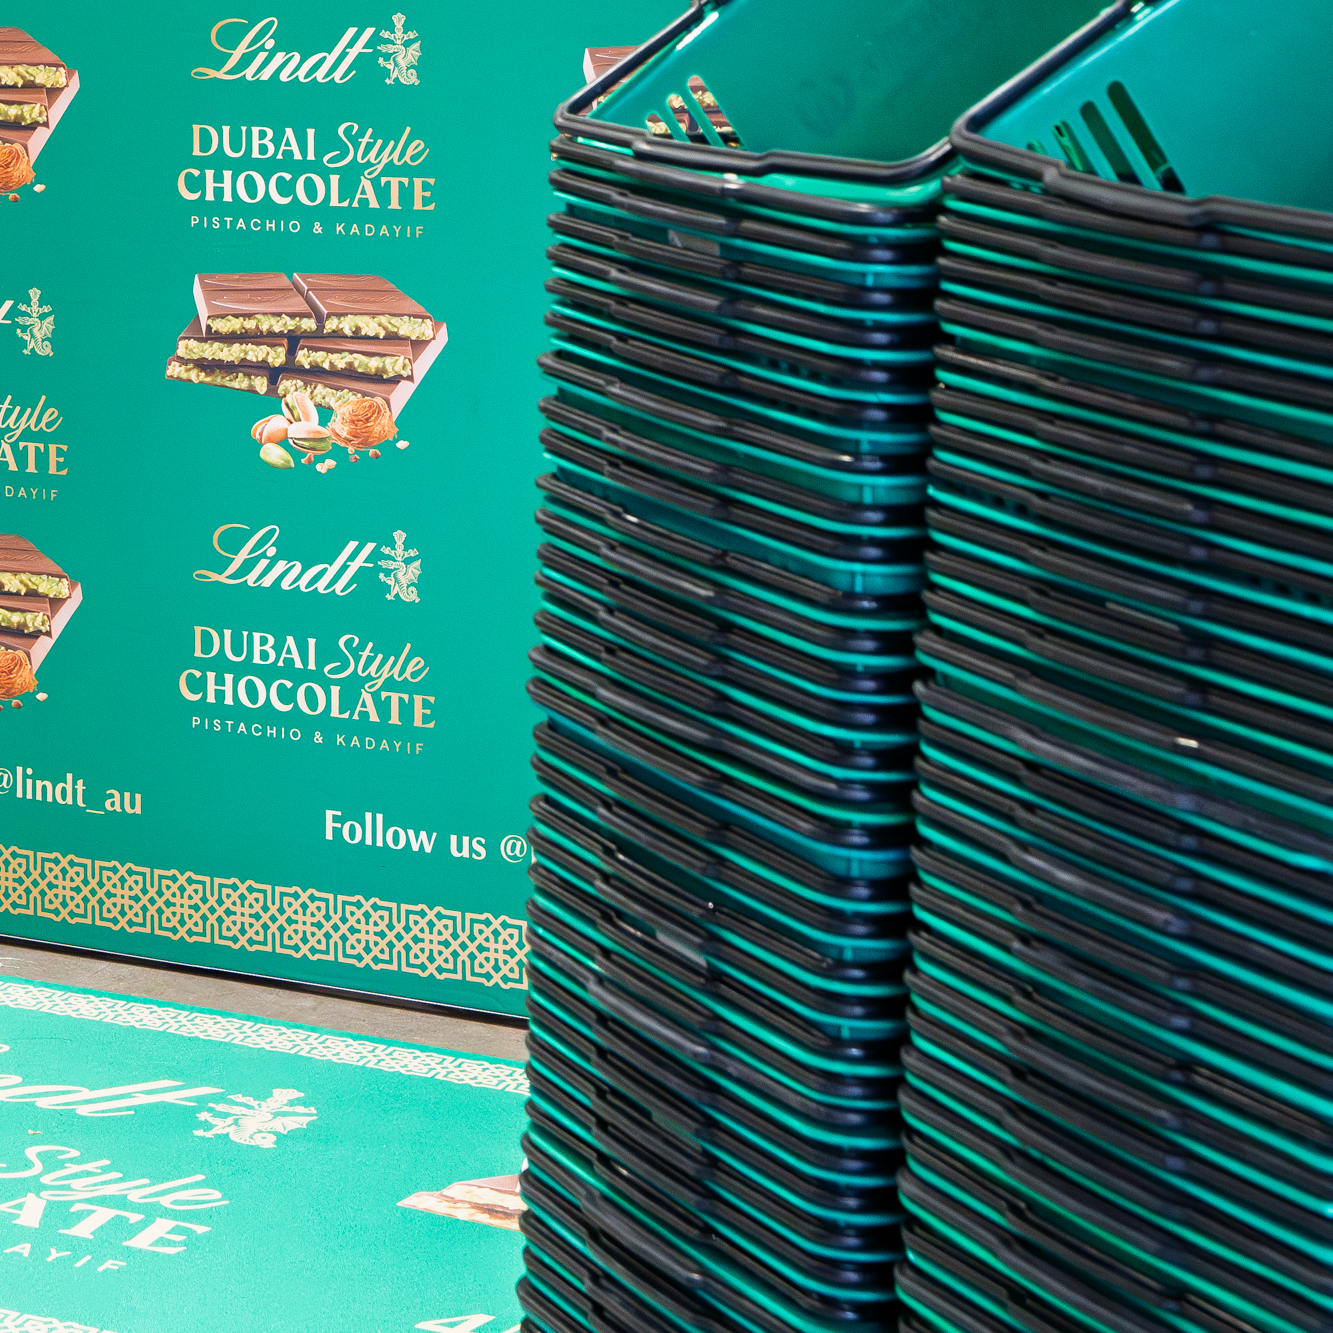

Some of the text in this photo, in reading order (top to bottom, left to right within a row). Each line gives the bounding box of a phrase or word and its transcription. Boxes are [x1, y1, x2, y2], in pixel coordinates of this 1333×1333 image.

[191, 17, 376, 84] Lindt
[192, 122, 429, 178] DUBAI Style
[177, 168, 435, 210] CHOCOLATE
[191, 216, 423, 238] PISTACHIO & KADAYIF
[193, 524, 377, 596] Lindt
[194, 626, 429, 692] DUBAI Style
[179, 669, 435, 728] CHOCOLATE
[192, 717, 423, 755] PISTACHIO & KADAYIF
[324, 810, 437, 855] Follow
[449, 831, 487, 861] us
